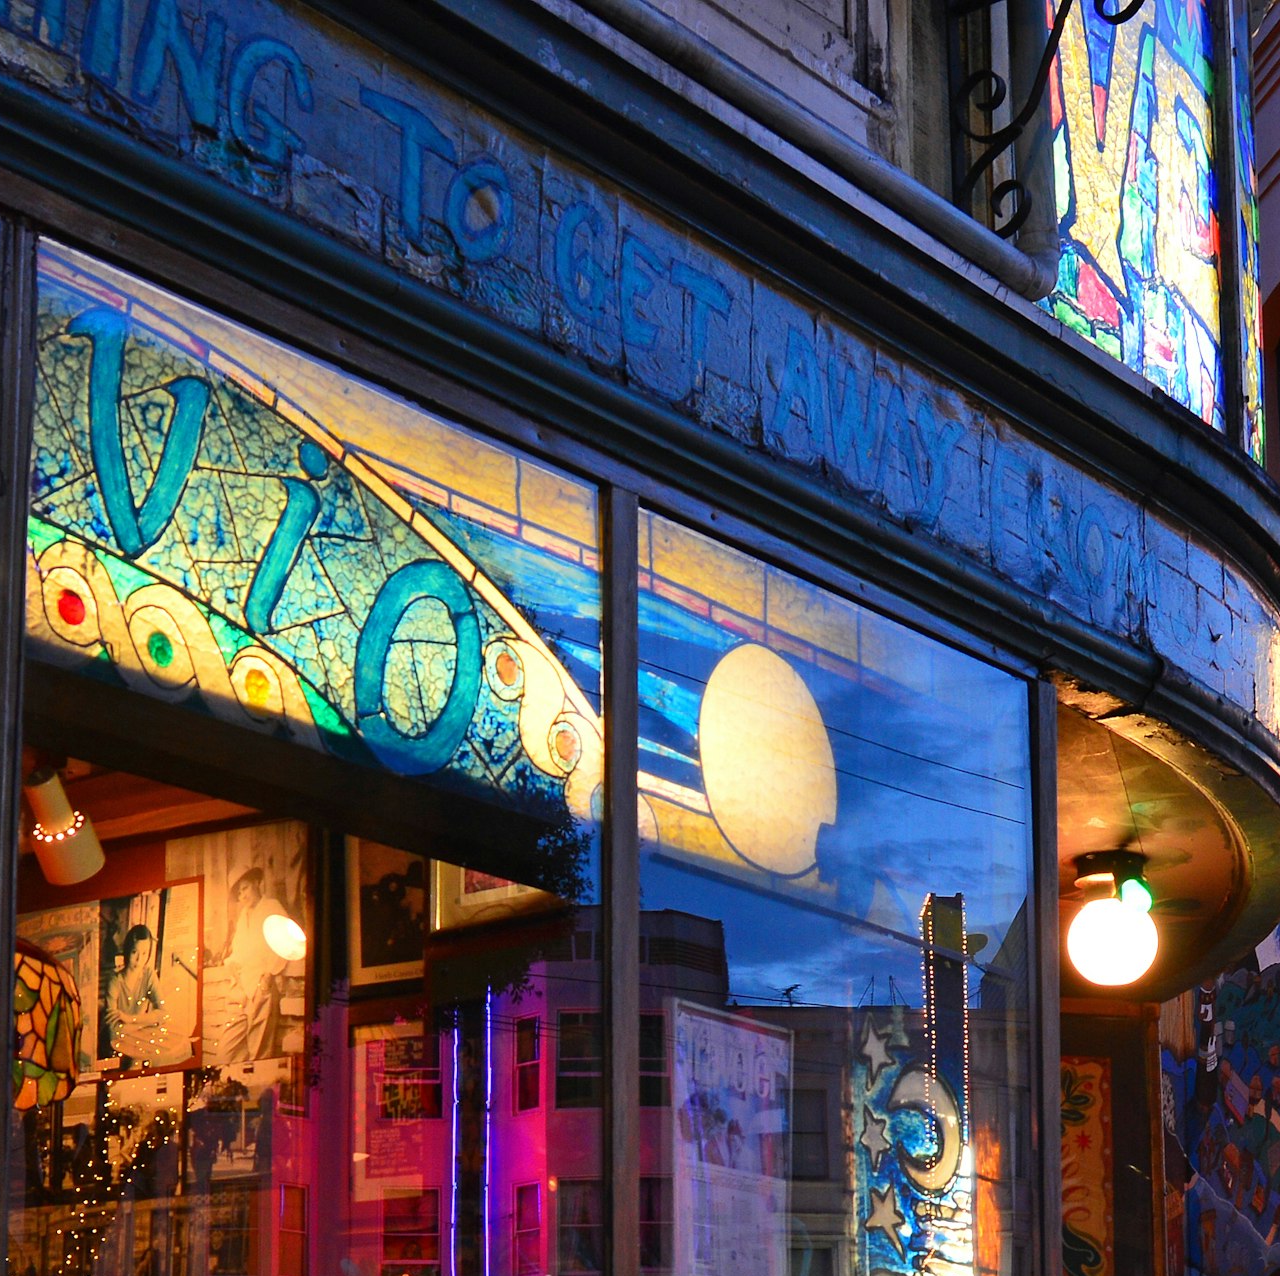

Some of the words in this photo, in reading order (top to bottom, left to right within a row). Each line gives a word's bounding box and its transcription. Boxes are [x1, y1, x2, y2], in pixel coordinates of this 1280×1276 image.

[359, 83, 514, 264] TO
[555, 199, 733, 397] GET
[770, 323, 965, 535] AWAY
